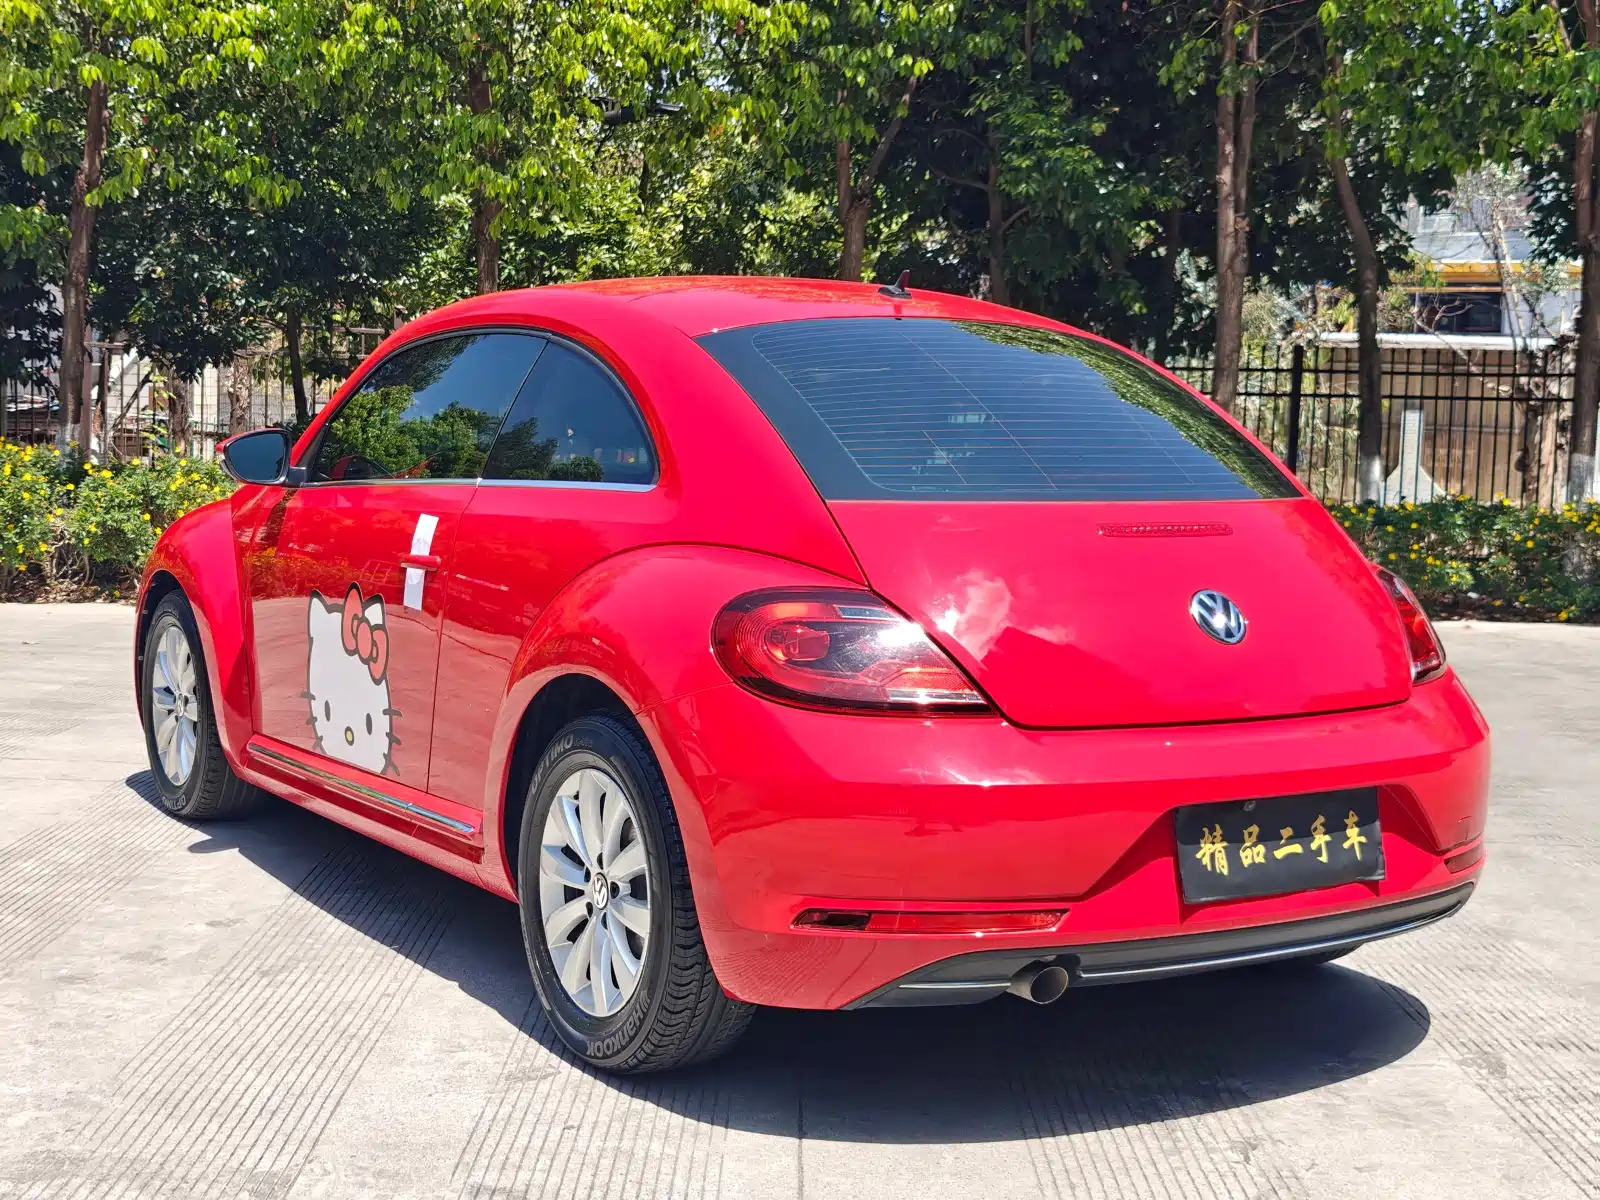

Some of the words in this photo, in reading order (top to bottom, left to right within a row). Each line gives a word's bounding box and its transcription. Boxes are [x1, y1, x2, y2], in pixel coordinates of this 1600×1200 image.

[531, 733, 574, 795] OPTIMO
[1195, 810, 1368, 876] 精品二手车
